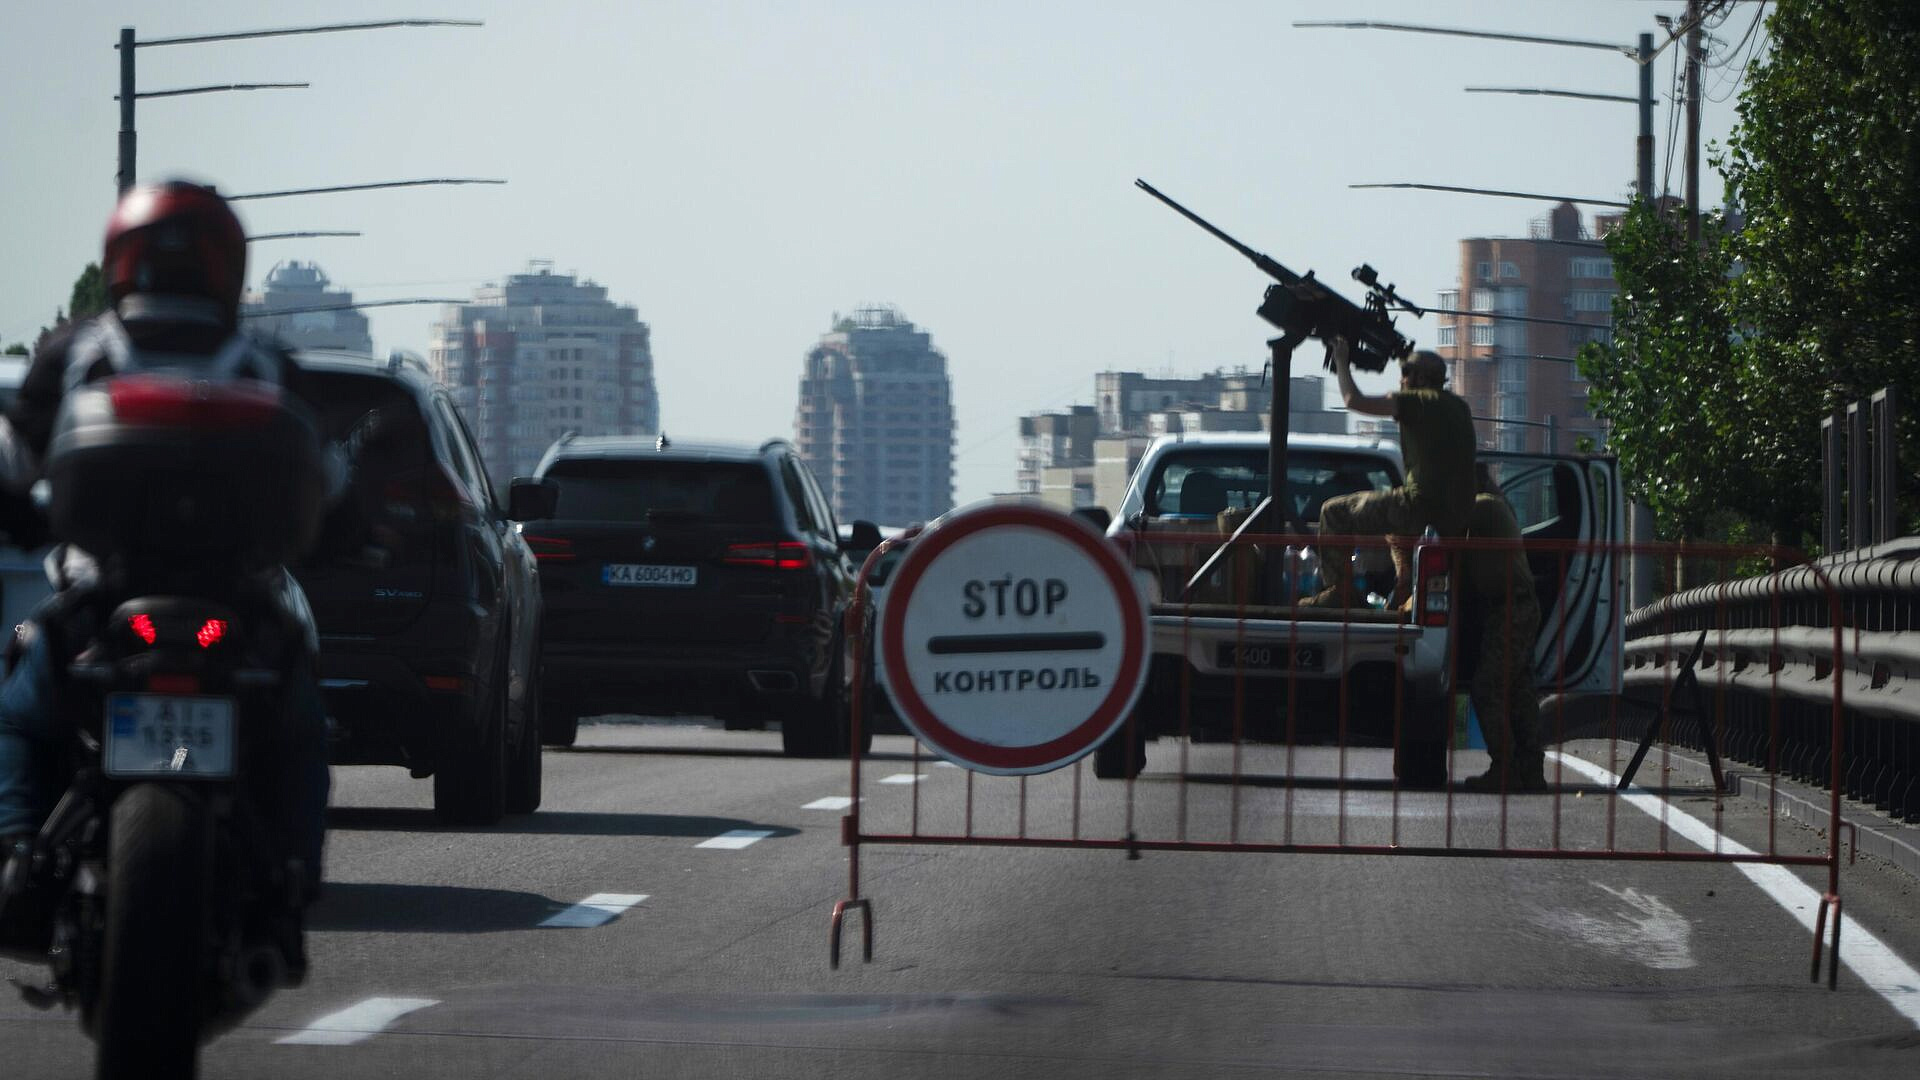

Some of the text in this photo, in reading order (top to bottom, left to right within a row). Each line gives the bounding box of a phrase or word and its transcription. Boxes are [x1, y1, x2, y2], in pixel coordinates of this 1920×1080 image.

[610, 566, 631, 581] KA
[636, 567, 670, 582] 6004
[963, 577, 1069, 618] STOP
[934, 667, 1101, 693] КОНТРОЛЬ
